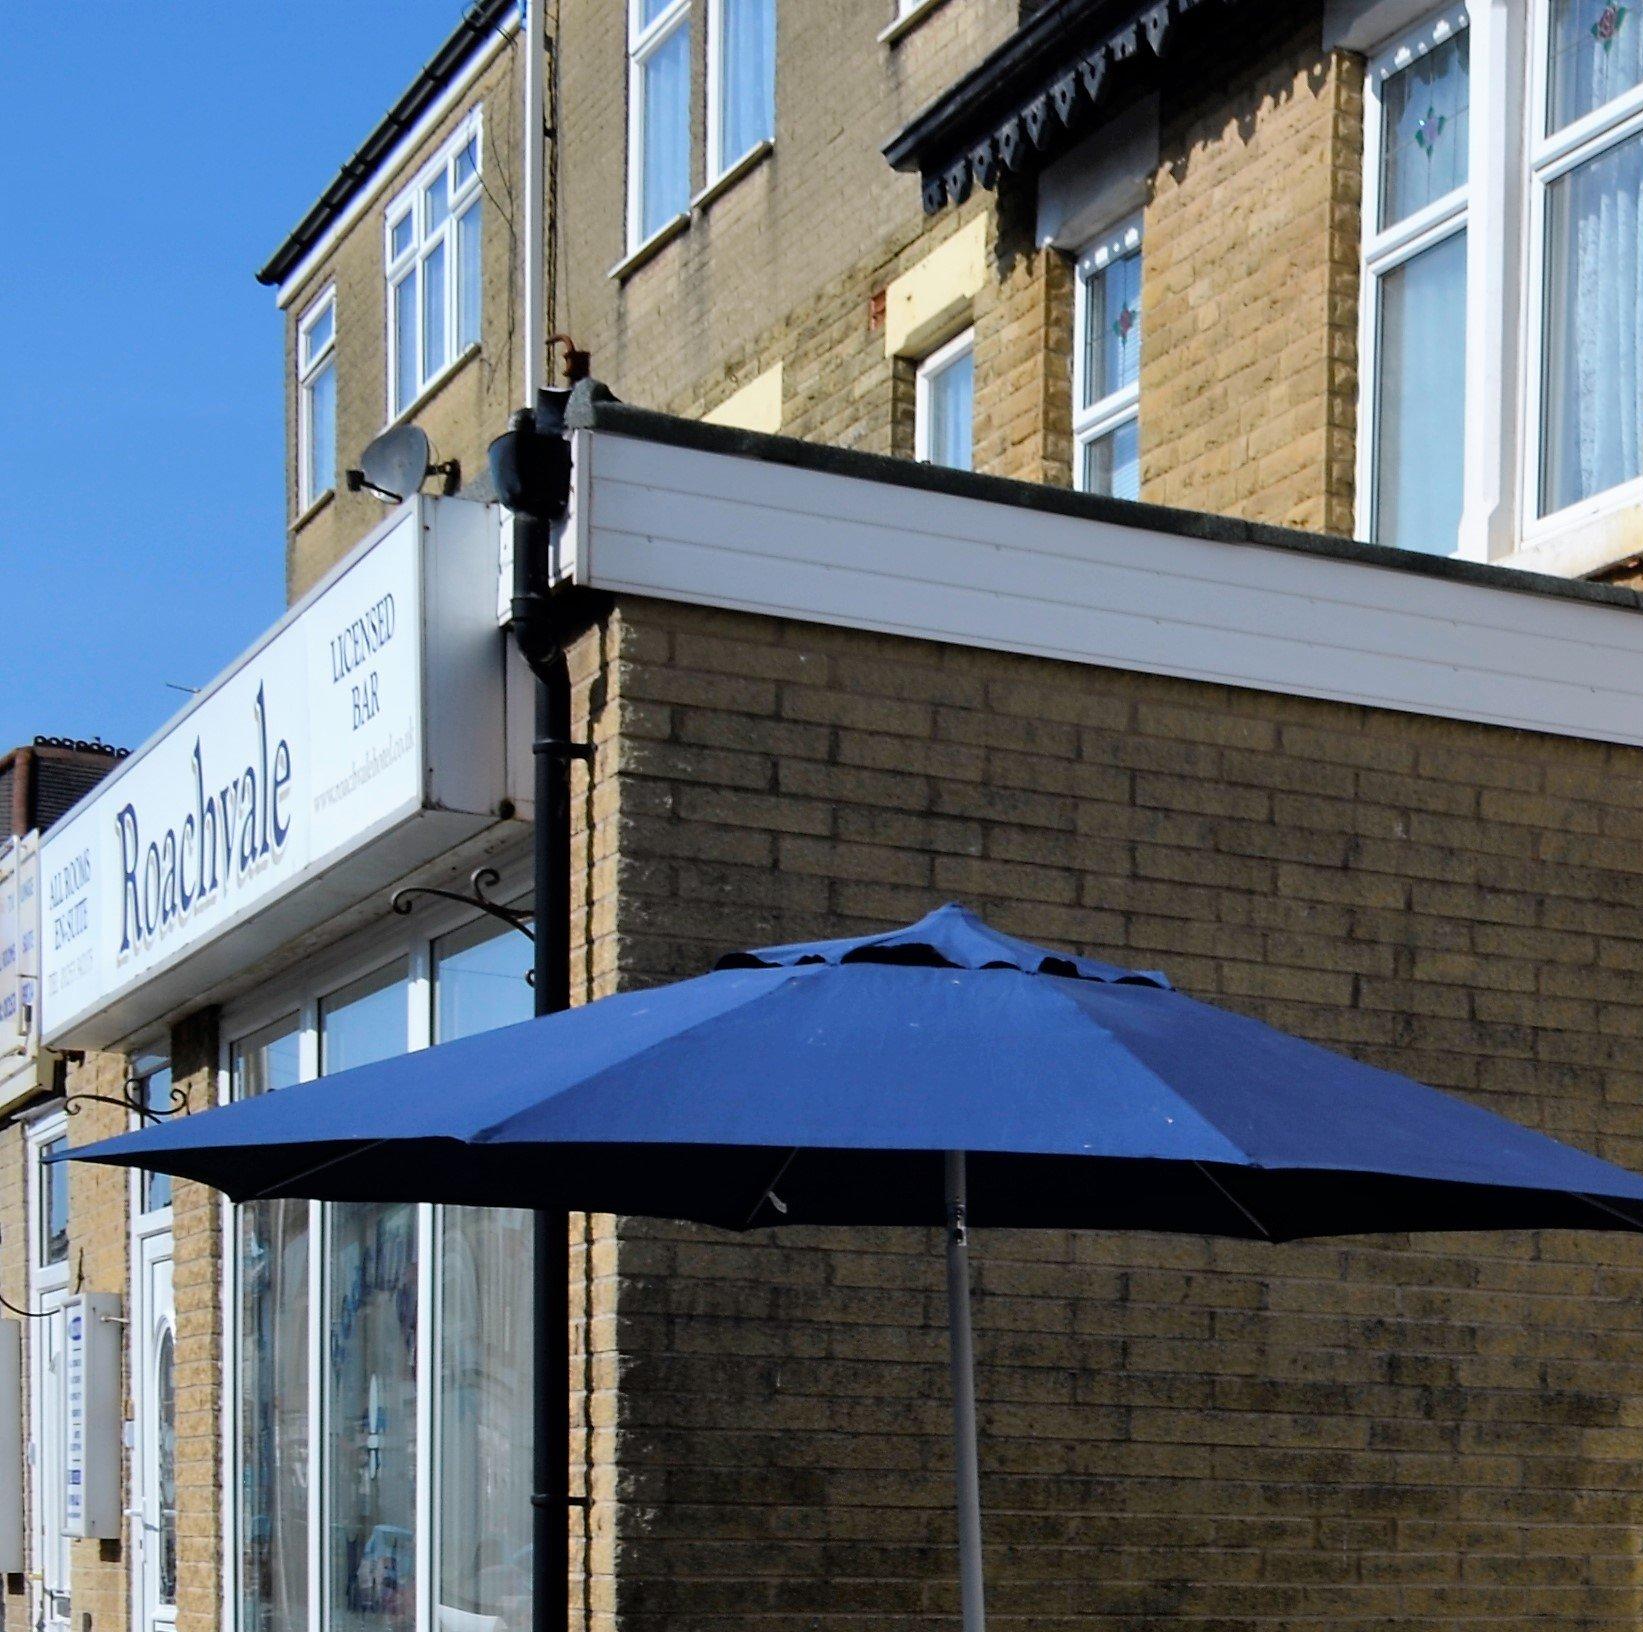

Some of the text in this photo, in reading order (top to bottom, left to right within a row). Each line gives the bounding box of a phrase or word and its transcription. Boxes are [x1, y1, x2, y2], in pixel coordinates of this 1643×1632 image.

[330, 592, 395, 684] LICENSED
[352, 671, 380, 732] BAR
[116, 678, 291, 954] Roachvale
